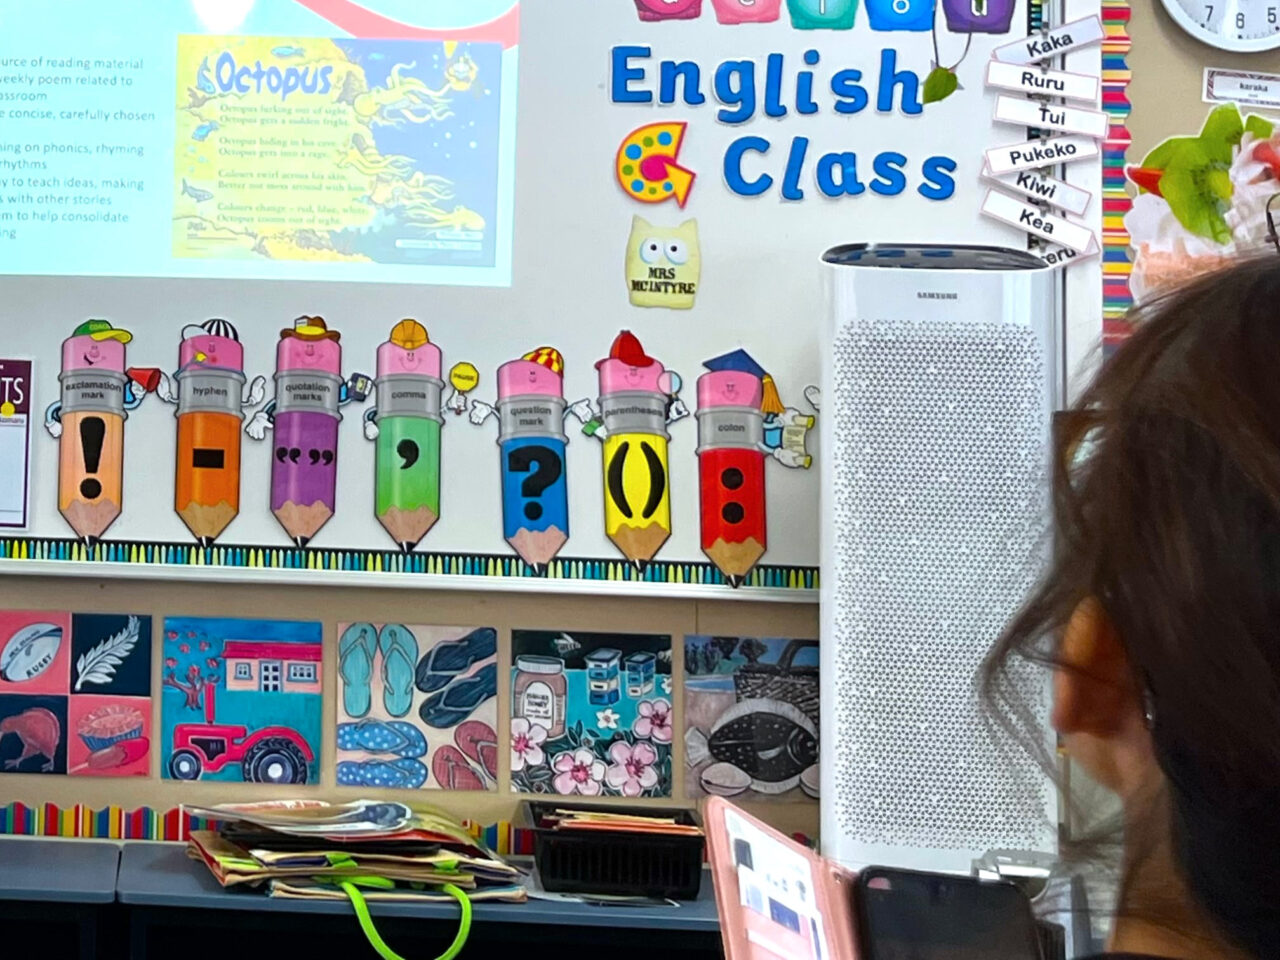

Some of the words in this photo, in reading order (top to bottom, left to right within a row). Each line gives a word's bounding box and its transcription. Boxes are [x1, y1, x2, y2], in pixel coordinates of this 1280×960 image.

[1205, 5, 1214, 22] 7
[1235, 12, 1245, 29] 6
[1267, 7, 1277, 24] 5
[1026, 32, 1075, 58] Kaka
[30, 56, 44, 68] of
[46, 57, 91, 70] reading
[94, 57, 144, 70] material
[37, 75, 72, 87] poem
[75, 74, 118, 86] related
[120, 75, 133, 86] to
[214, 50, 334, 102] Octopus
[1021, 70, 1066, 91] Ruru
[610, 45, 924, 124] English
[8, 108, 57, 121] concise,
[59, 108, 110, 123] carefully
[113, 110, 156, 122] chosen
[1038, 107, 1066, 126] Tui
[24, 143, 40, 153] on
[43, 142, 93, 156] phonics,
[95, 143, 145, 157] rhyming
[1009, 141, 1078, 165] Pukeko
[722, 135, 959, 202] Class
[11, 177, 24, 187] to
[27, 176, 61, 188] teach
[63, 176, 98, 190] ideas,
[101, 178, 145, 192] making
[1015, 170, 1057, 200] Kiwi
[7, 194, 34, 205] with
[36, 194, 69, 205] other
[72, 195, 113, 206] stories
[16, 212, 30, 222] to
[32, 211, 59, 224] help
[61, 211, 130, 223] consolidate
[1019, 208, 1055, 235] Kea
[648, 267, 676, 280] MRS
[917, 292, 958, 300] SAMSUNG
[66, 379, 122, 393] exclamation
[193, 385, 229, 398] hyphen
[285, 382, 331, 394] quotation
[81, 390, 105, 400] mark
[292, 392, 322, 402] marks
[391, 390, 427, 399] comma
[510, 406, 552, 418] question
[605, 405, 664, 418] parentheses
[518, 416, 545, 426] mark
[717, 423, 746, 433] colon
[26, 653, 53, 679] RUGBY
